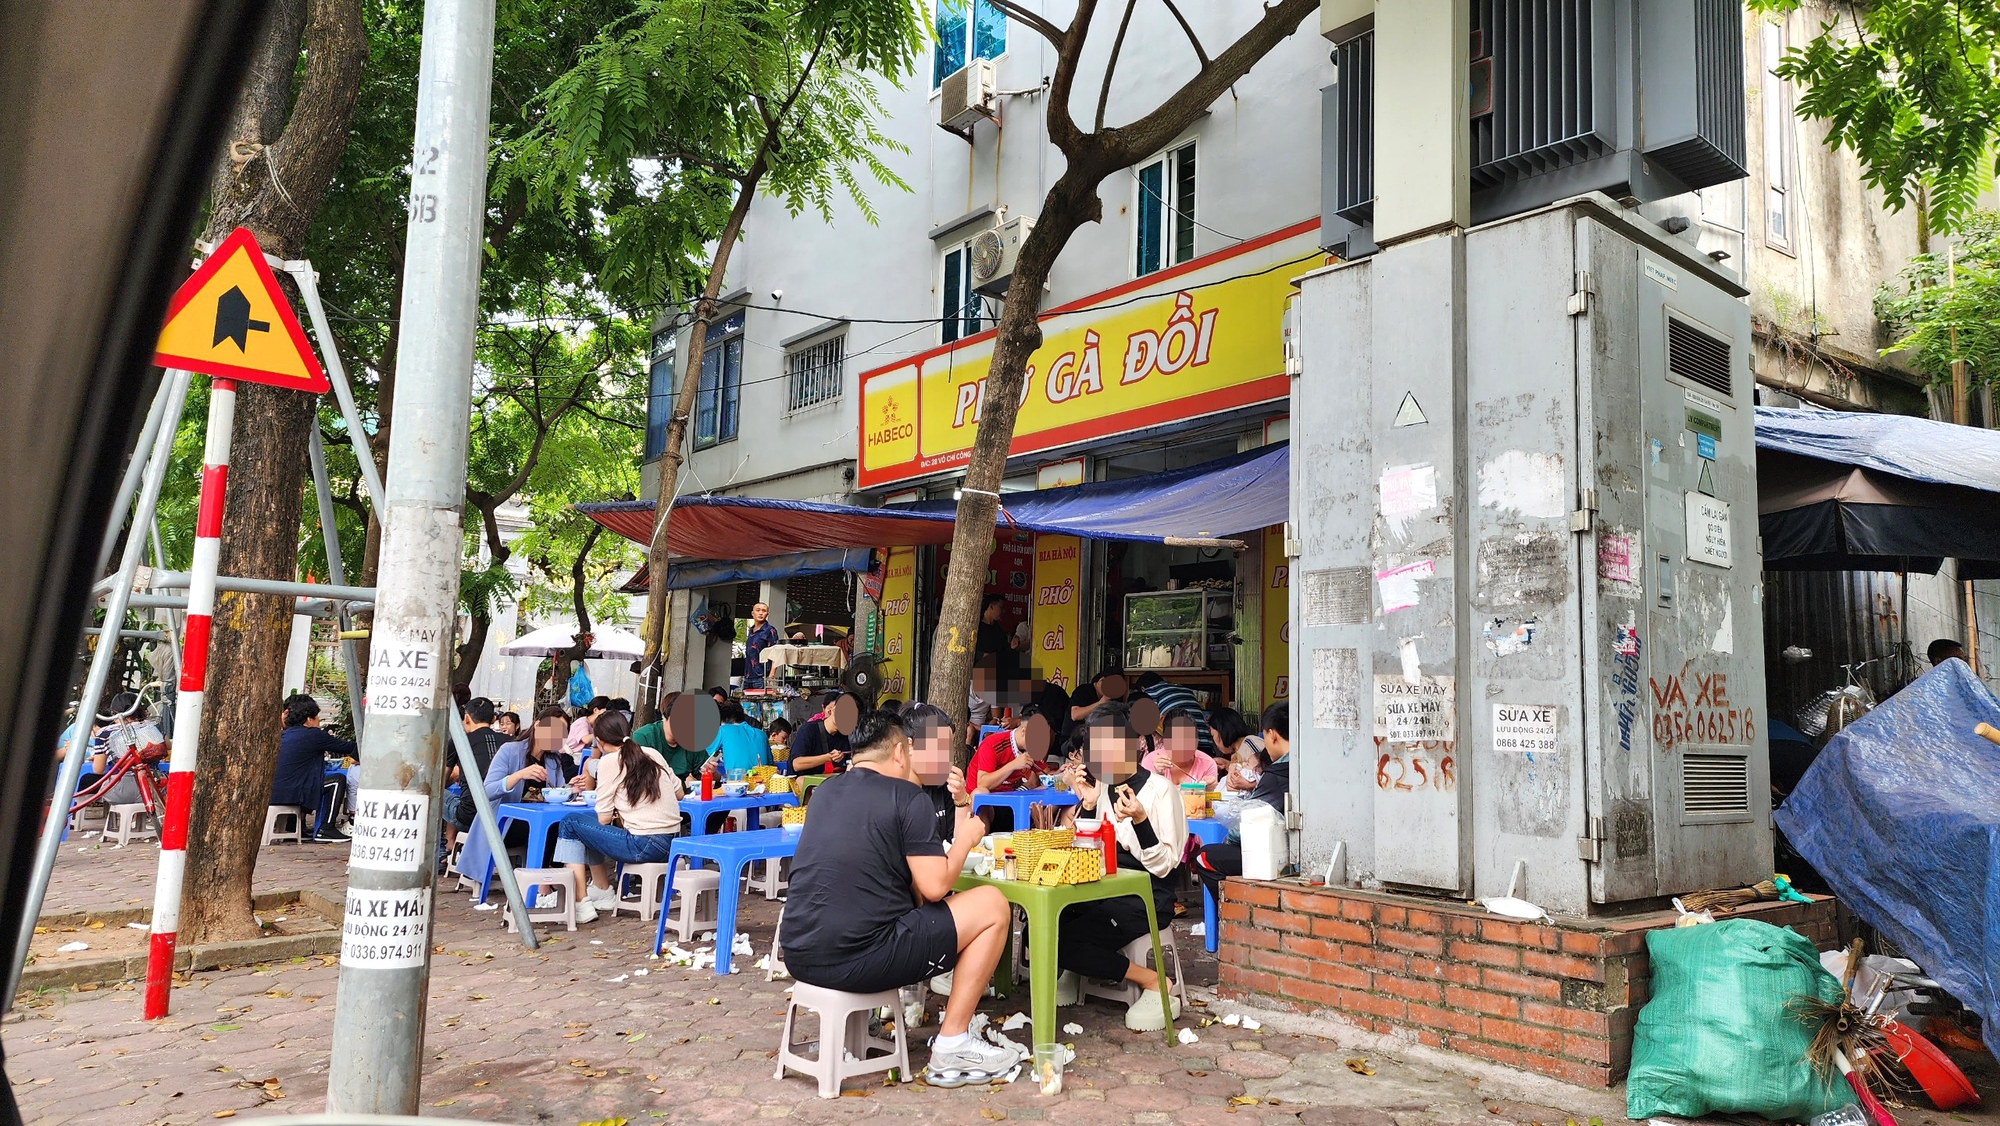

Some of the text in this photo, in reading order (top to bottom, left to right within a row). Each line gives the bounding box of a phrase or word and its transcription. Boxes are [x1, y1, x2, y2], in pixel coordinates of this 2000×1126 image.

[1045, 328, 1104, 405] GÀ
[1119, 290, 1220, 387] ĐỒI
[868, 423, 914, 448] HABECO
[1039, 546, 1077, 562] BIA HÀ NỘI
[1038, 578, 1075, 606] PHỞ
[883, 593, 911, 616] PHỞ
[887, 632, 903, 655] GÀ
[1043, 624, 1065, 652] GÀ
[397, 650, 429, 669] XE
[400, 676, 431, 688] 24/24
[1406, 684, 1420, 695] XE
[1694, 672, 1730, 709] XE
[374, 695, 398, 709] 425
[1407, 702, 1419, 714] XE
[1532, 709, 1551, 723] XE
[1496, 738, 1554, 750] 0868 425 388
[362, 800, 379, 819] XE
[383, 800, 421, 820] MÁY
[381, 827, 418, 840] 24/24
[367, 900, 389, 918] XE
[354, 922, 389, 939] ĐỘNG
[393, 923, 424, 937] 24/24
[350, 942, 423, 961] 0336.974.911
